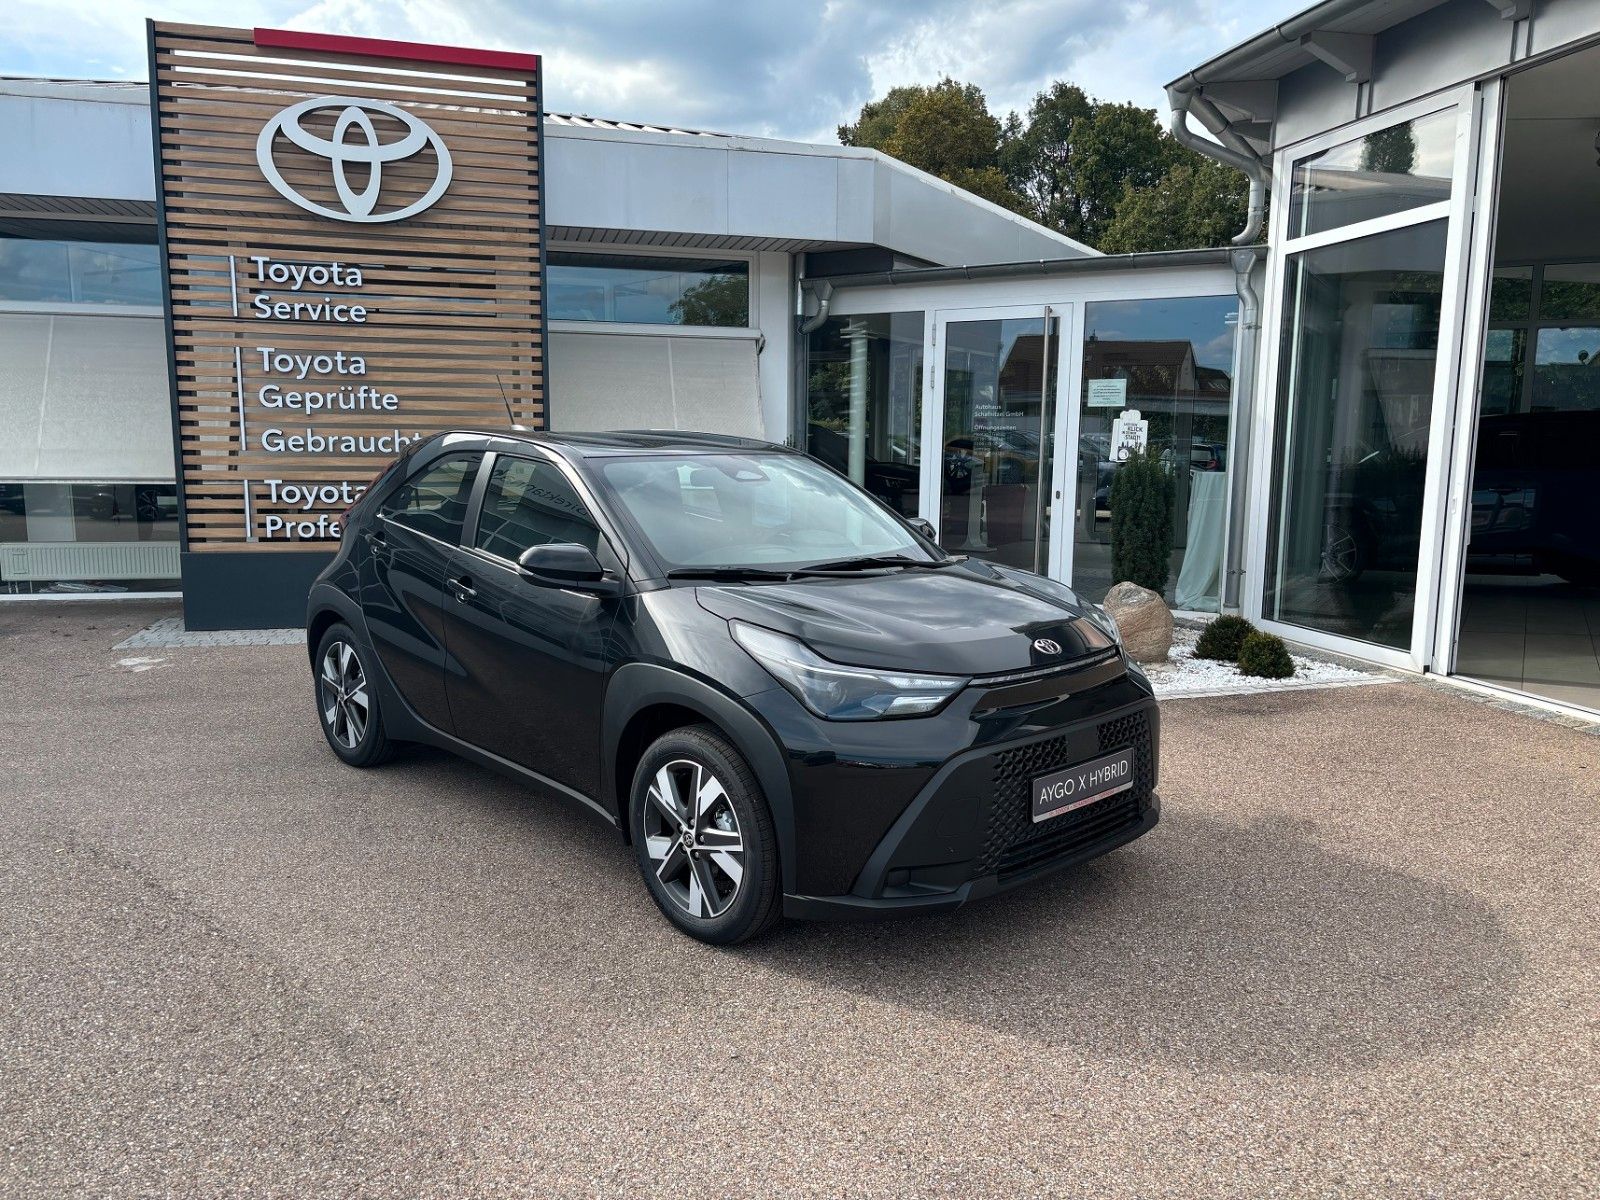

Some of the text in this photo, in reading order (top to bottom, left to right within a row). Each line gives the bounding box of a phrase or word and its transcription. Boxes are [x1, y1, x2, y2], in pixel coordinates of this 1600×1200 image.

[250, 255, 363, 291] Toyota
[254, 294, 368, 323] Service
[256, 346, 367, 380] Toyota
[258, 384, 399, 415] Geprüfte
[1039, 778, 1075, 805] AYGO
[1078, 774, 1087, 792] X
[1089, 760, 1128, 788] HYBRID
